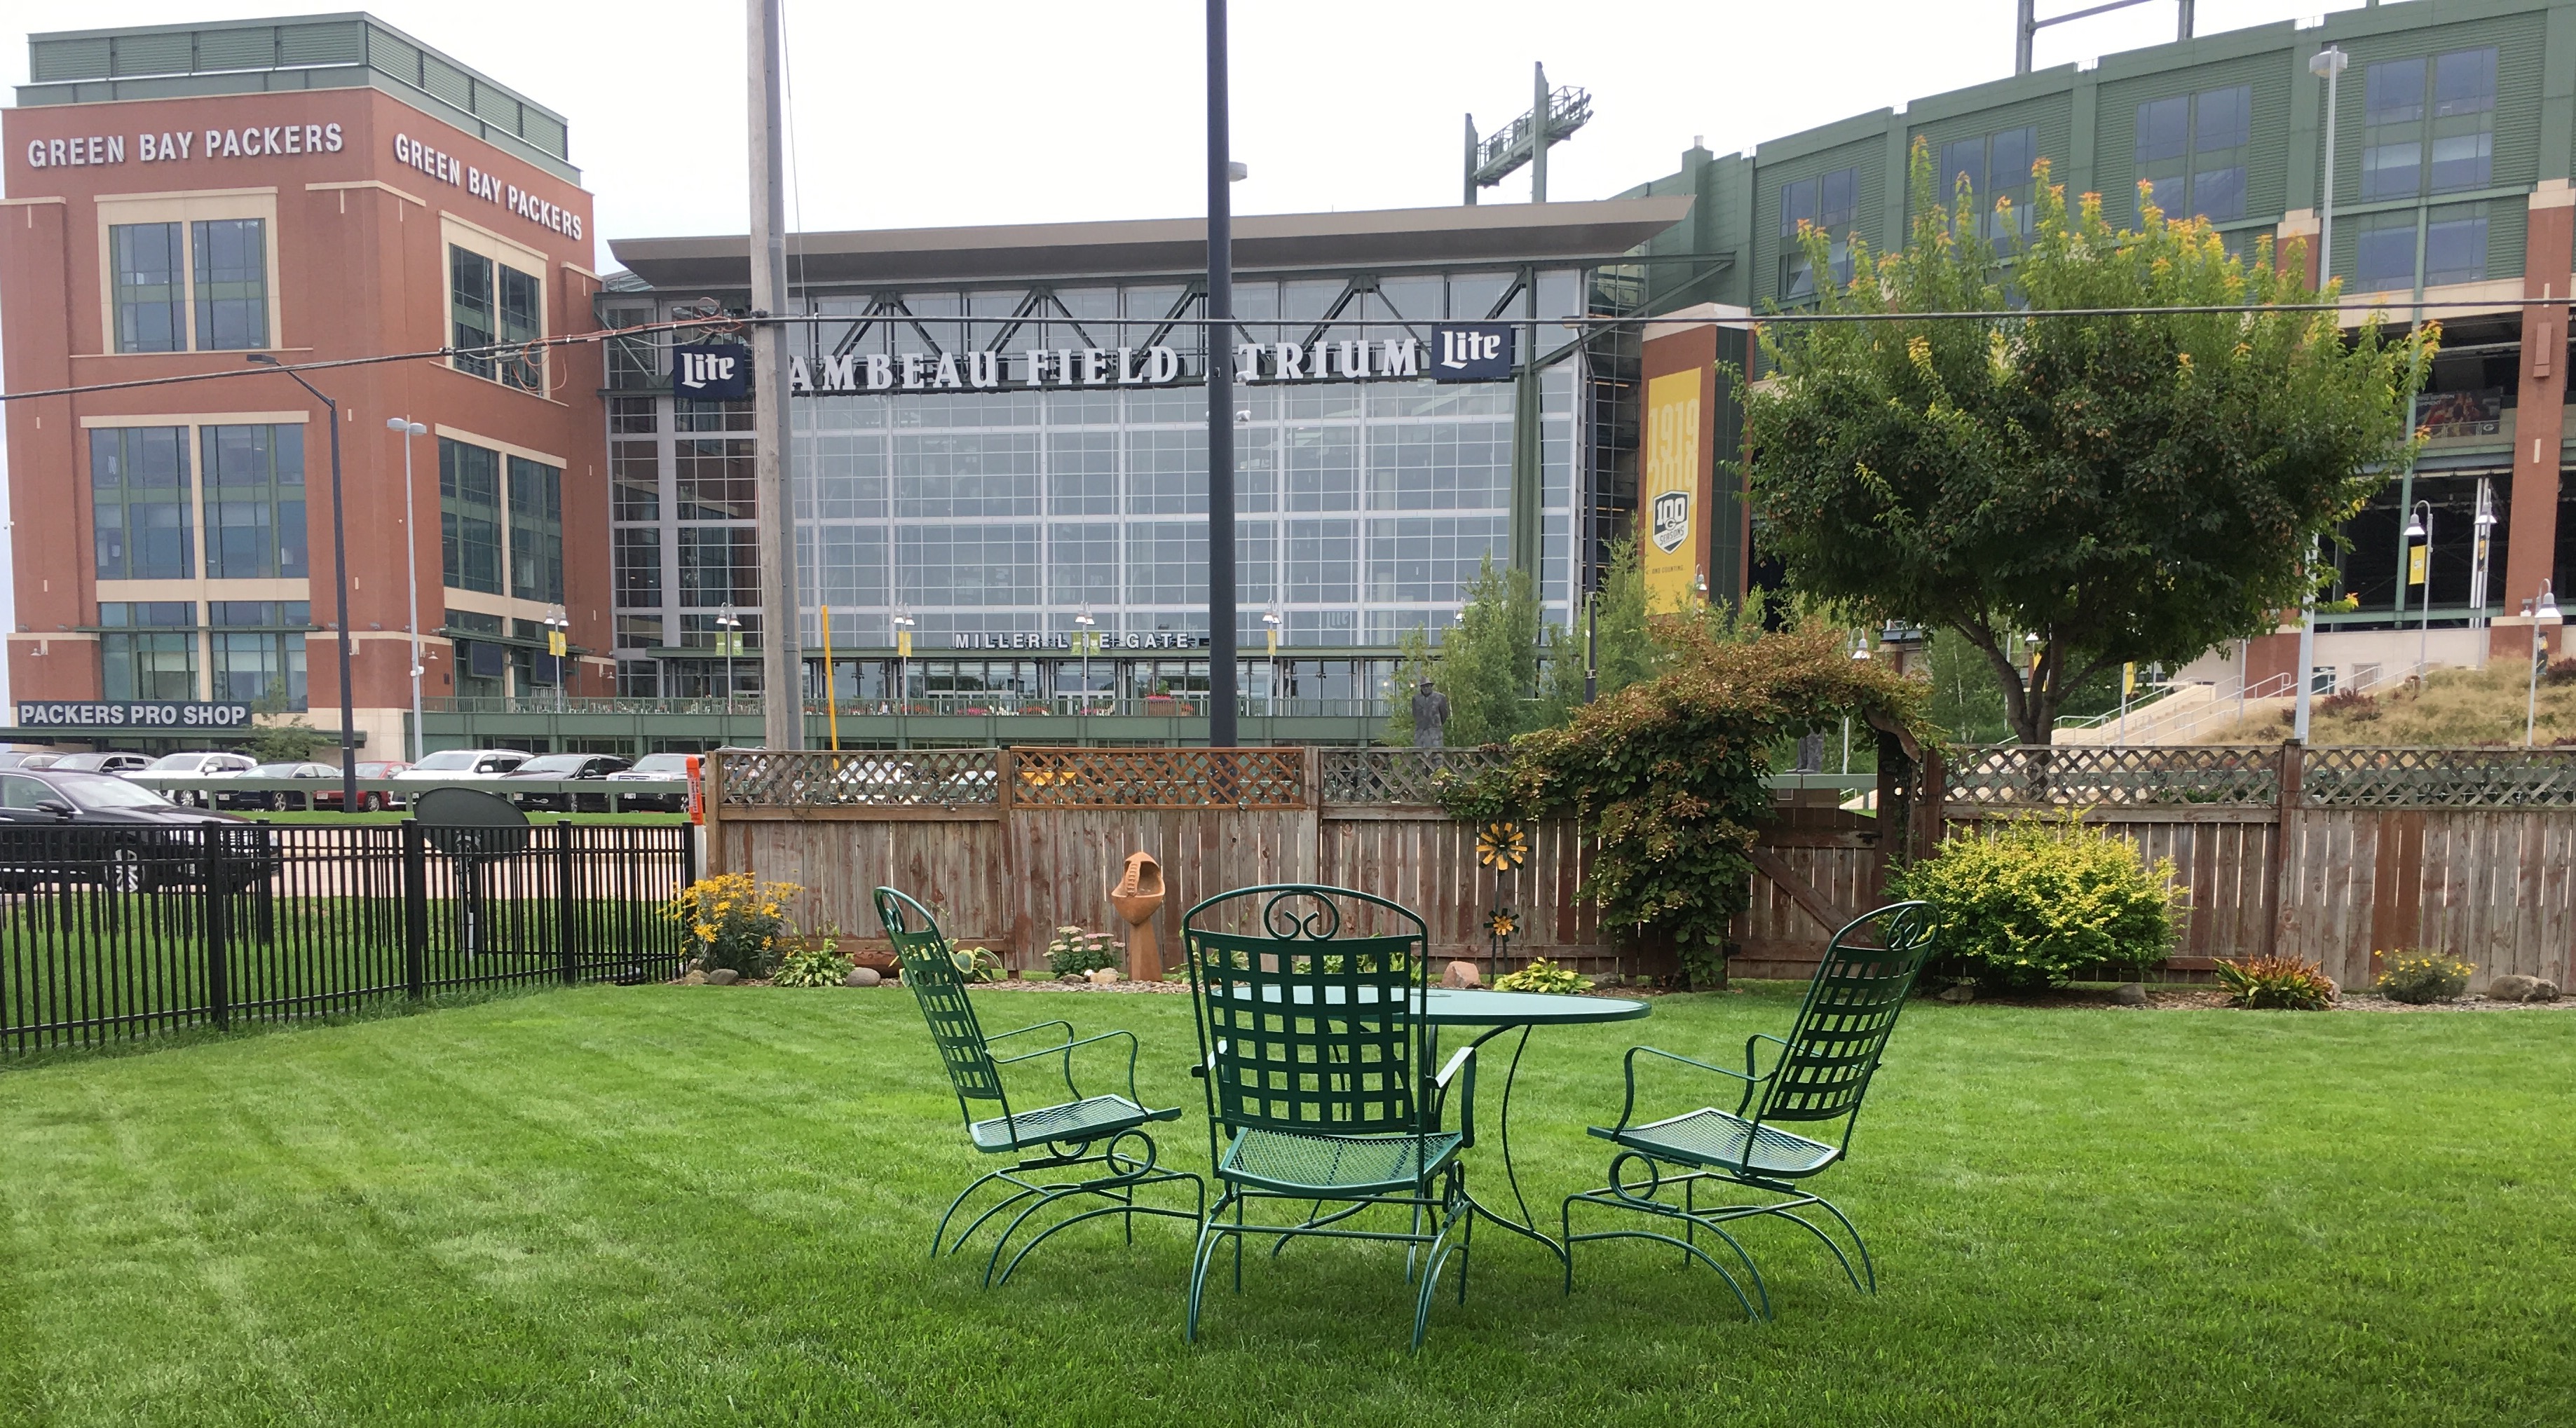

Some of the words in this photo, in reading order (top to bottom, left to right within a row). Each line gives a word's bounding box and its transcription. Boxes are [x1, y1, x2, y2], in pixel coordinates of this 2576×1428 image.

[28, 135, 125, 168] GREEN
[139, 131, 193, 162] BAY
[205, 123, 343, 158] PACKERS
[394, 132, 461, 187] GREEN
[467, 165, 502, 204] BAY
[506, 184, 582, 241] PACKERS
[789, 350, 999, 392] AMBEAU
[1025, 346, 1179, 386] FIELD
[1238, 338, 1419, 381] TRIUM
[1440, 331, 1501, 369] Lite
[681, 353, 735, 389] Lite
[1649, 398, 1700, 460] 1919
[1656, 497, 1686, 526] 100
[1659, 525, 1684, 545] SEASONS
[955, 633, 1041, 648] MILLER
[1126, 633, 1189, 648] GATE
[20, 705, 125, 724] PACKERS
[130, 705, 177, 725] PRO
[183, 705, 246, 726] SHOP
